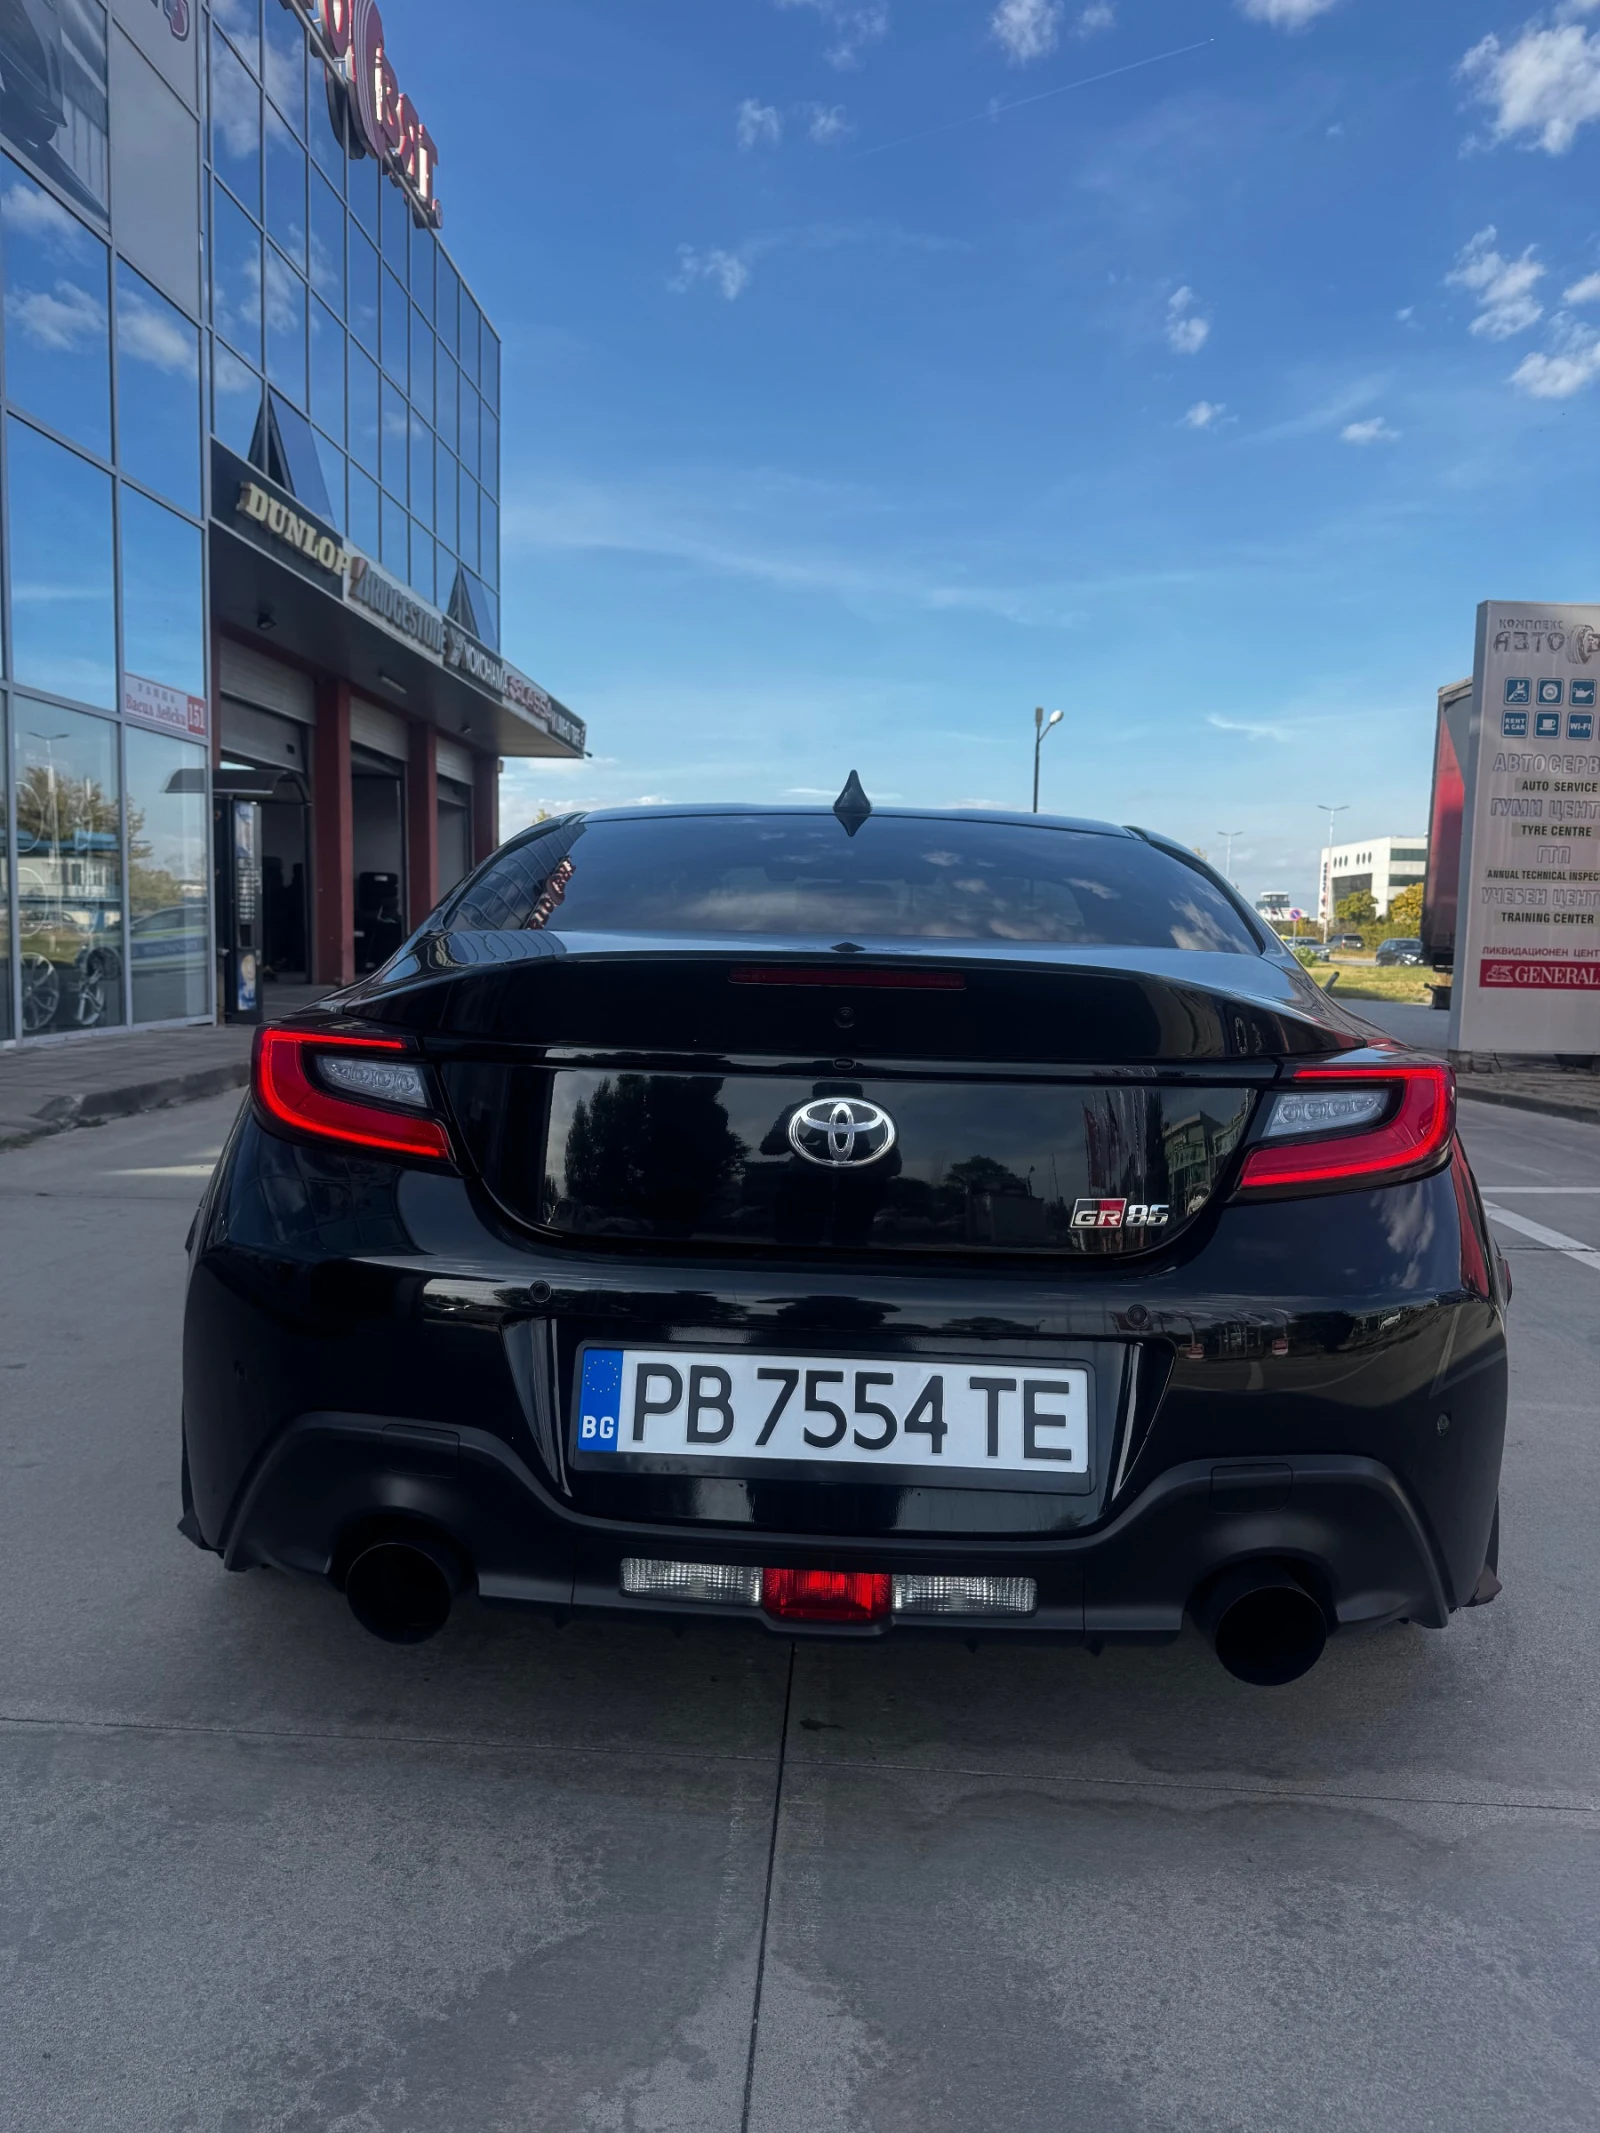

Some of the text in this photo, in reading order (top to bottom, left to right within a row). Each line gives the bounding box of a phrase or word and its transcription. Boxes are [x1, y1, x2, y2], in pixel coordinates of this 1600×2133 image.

[245, 482, 352, 577] DUNLOP
[354, 566, 448, 656] BRIDGESTONE
[1498, 618, 1564, 630] КОМПЛЕКС
[188, 703, 206, 729] 151
[1492, 752, 1600, 775] АВТОСЕРВ
[1521, 780, 1598, 793] AUTO SERVICE
[1490, 797, 1600, 821] ГУМИ ЦЕНТ
[1521, 824, 1592, 837] TYRE CENTRE
[1487, 869, 1600, 882] ANNUAL TECHNICAL INSPEC
[1481, 887, 1548, 906] УЧЕБЕН
[1501, 912, 1595, 925] TRAINING CENTER
[1482, 946, 1569, 957] ЛИКВИДАЦИОНЕН
[1515, 965, 1600, 985] GENERAL
[1074, 1203, 1169, 1227] GR 86
[631, 1361, 1073, 1462] PB 7554 TE
[581, 1414, 615, 1440] BG
